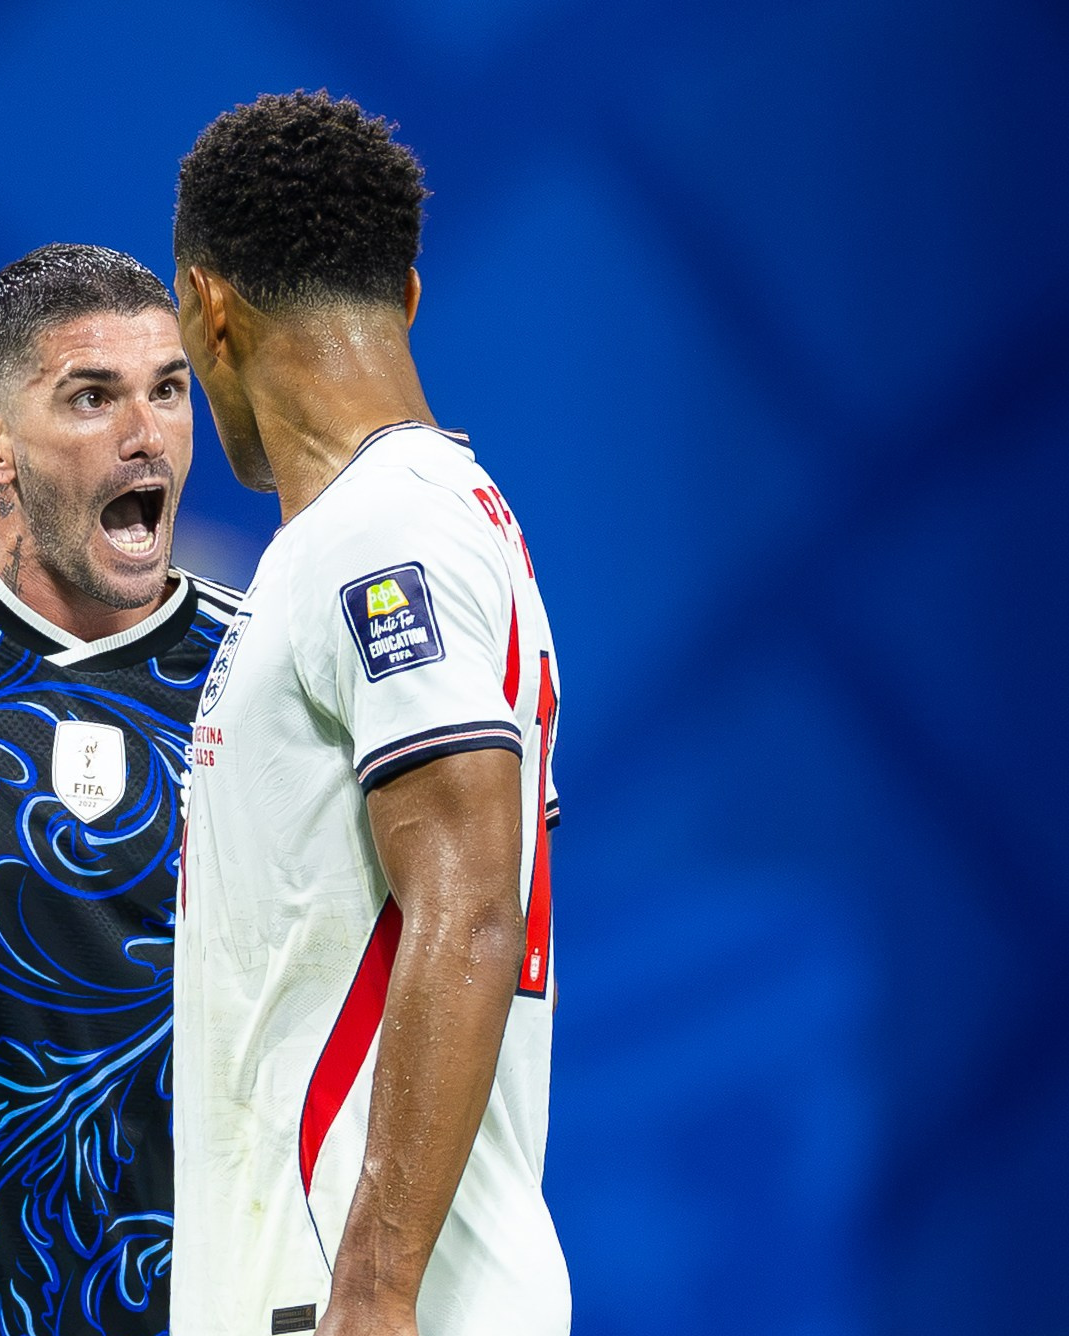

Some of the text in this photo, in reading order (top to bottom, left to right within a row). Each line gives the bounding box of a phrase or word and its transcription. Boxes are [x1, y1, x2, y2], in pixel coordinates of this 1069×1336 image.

[368, 626, 429, 659] EDUCATION
[388, 649, 414, 663] FIFA
[74, 783, 104, 796] FIFA
[78, 800, 97, 808] 2022
